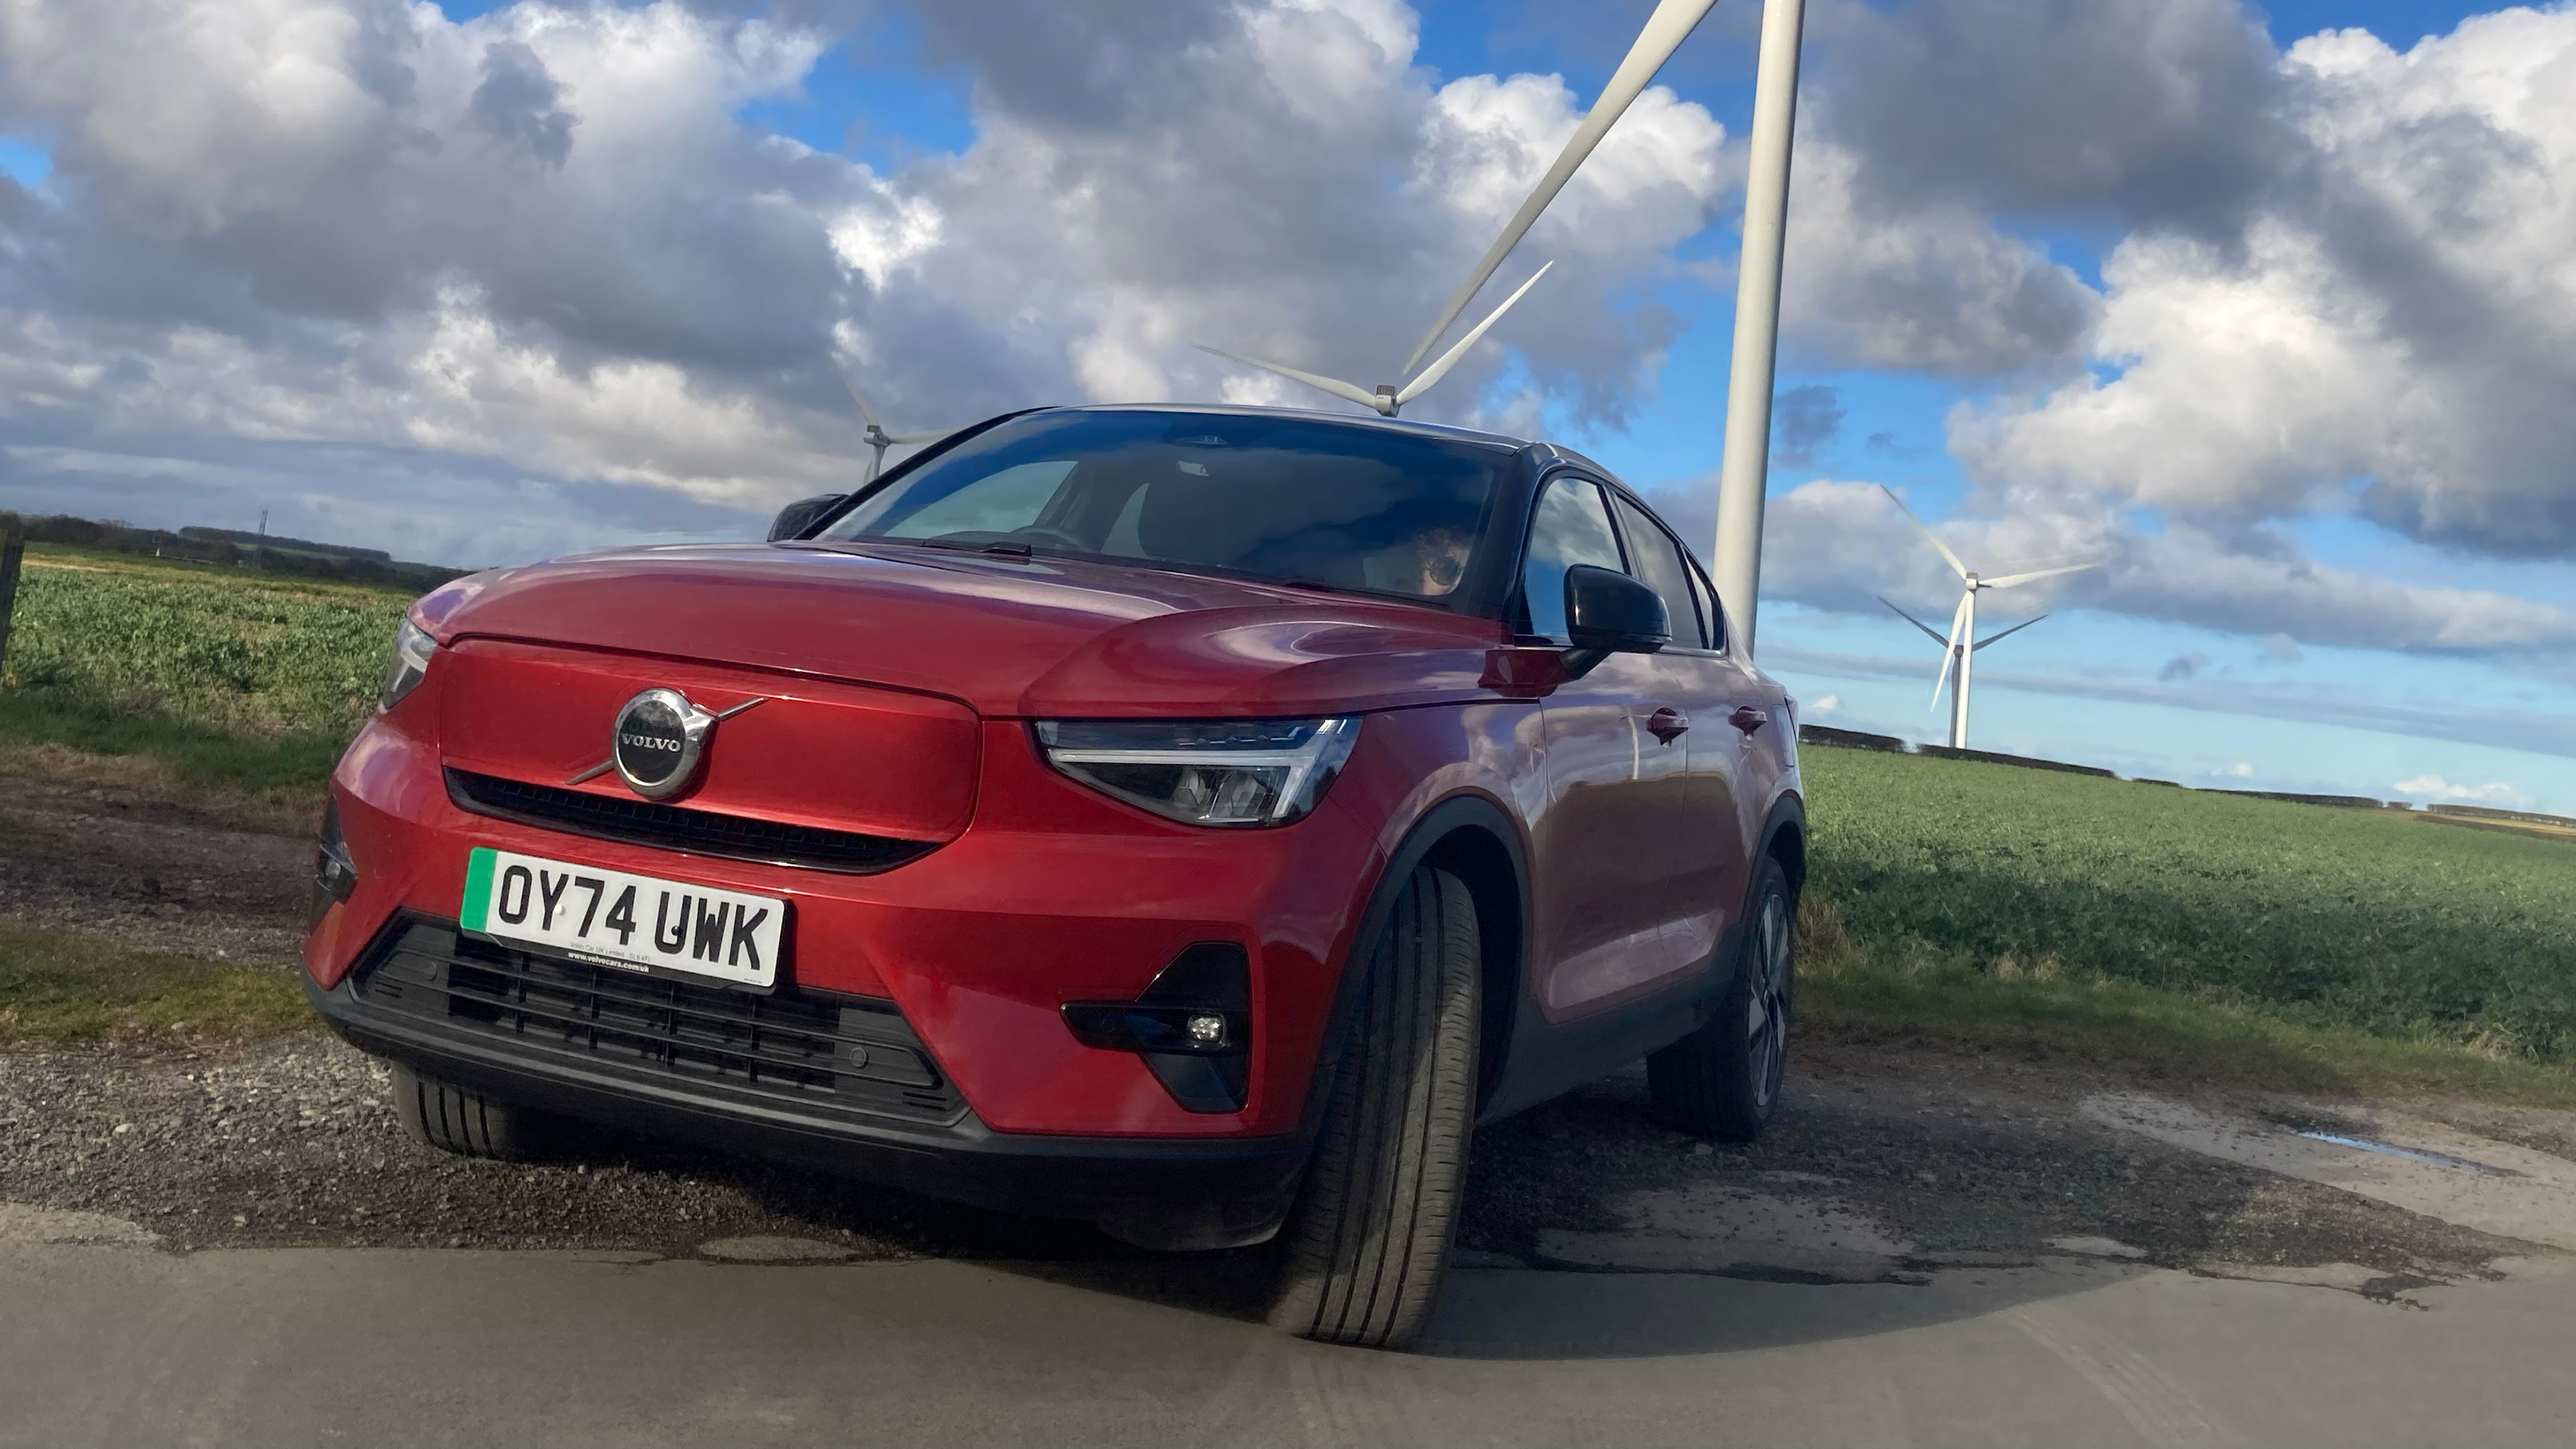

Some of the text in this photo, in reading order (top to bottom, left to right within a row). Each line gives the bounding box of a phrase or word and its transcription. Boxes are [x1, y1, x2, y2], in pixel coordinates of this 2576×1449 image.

[621, 733, 681, 753] VOLVO
[498, 865, 769, 971] OY74 UWK
